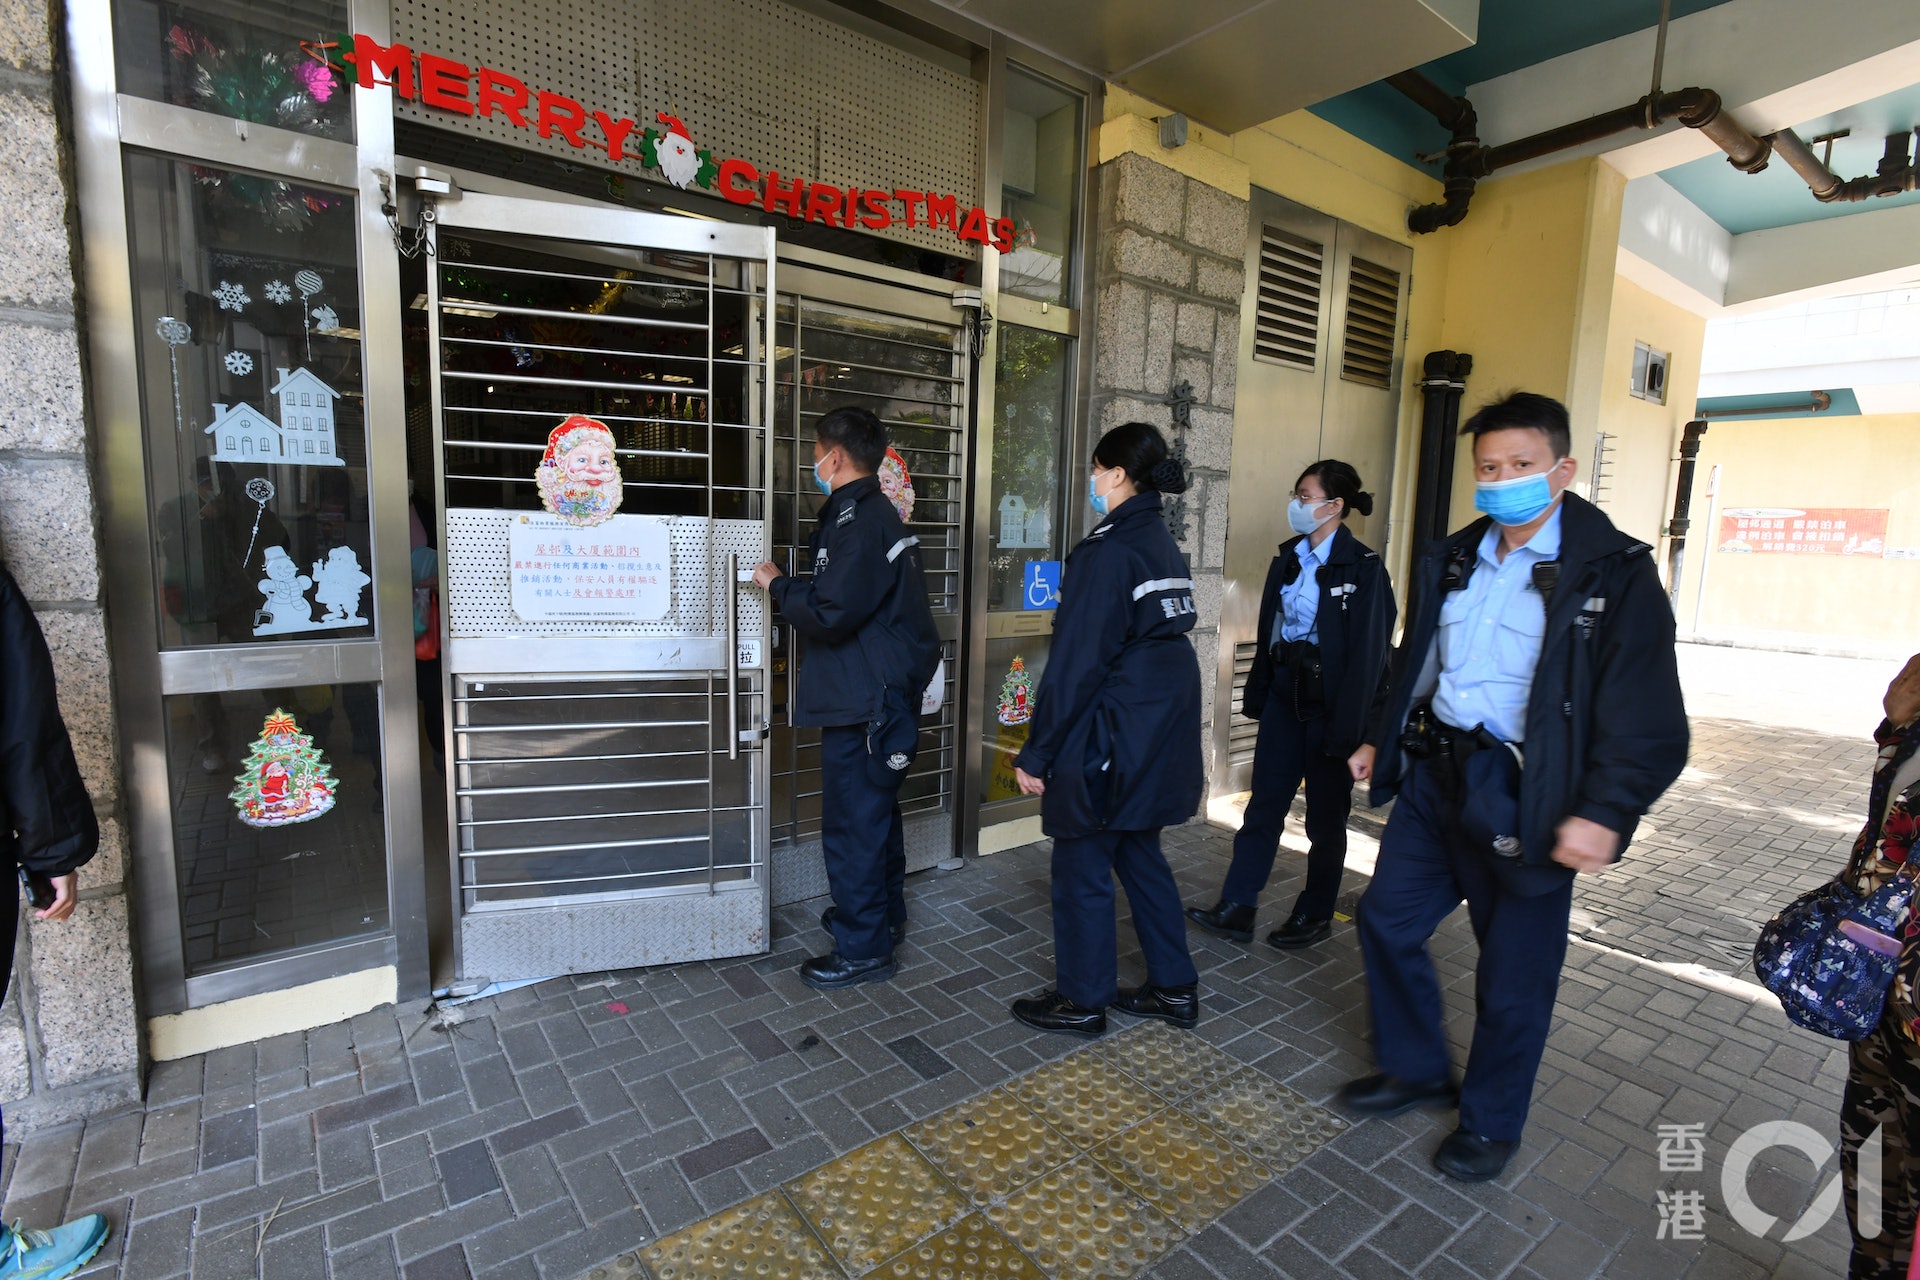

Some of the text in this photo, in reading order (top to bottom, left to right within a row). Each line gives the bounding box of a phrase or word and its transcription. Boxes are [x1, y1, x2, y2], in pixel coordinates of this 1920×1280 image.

[354, 33, 1017, 254] MERRY CHRISTMAS
[740, 651, 753, 664] 拉
